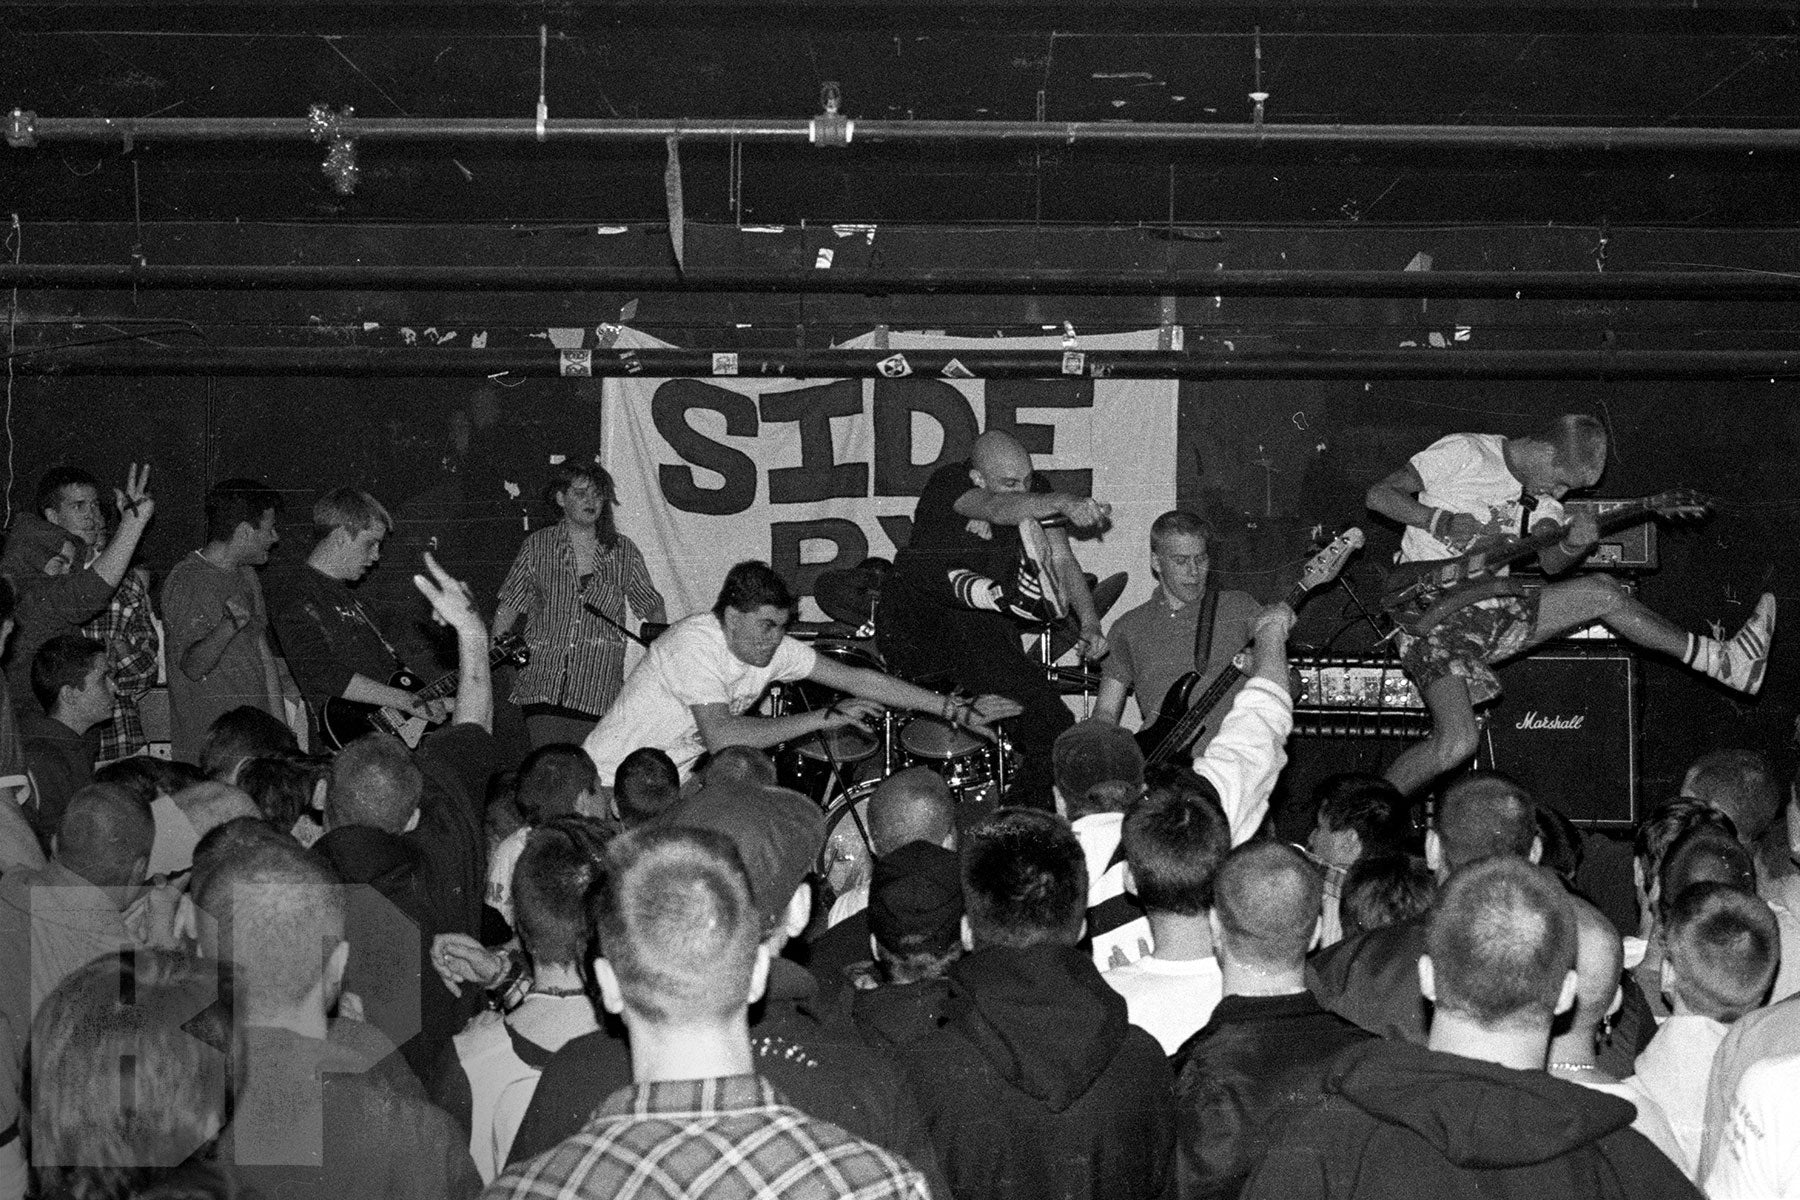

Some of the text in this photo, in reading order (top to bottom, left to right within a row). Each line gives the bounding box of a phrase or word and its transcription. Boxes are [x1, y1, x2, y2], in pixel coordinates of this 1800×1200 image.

[651, 377, 1093, 515] SIDE
[770, 515, 920, 636] B
[1515, 711, 1585, 730] Marshall
